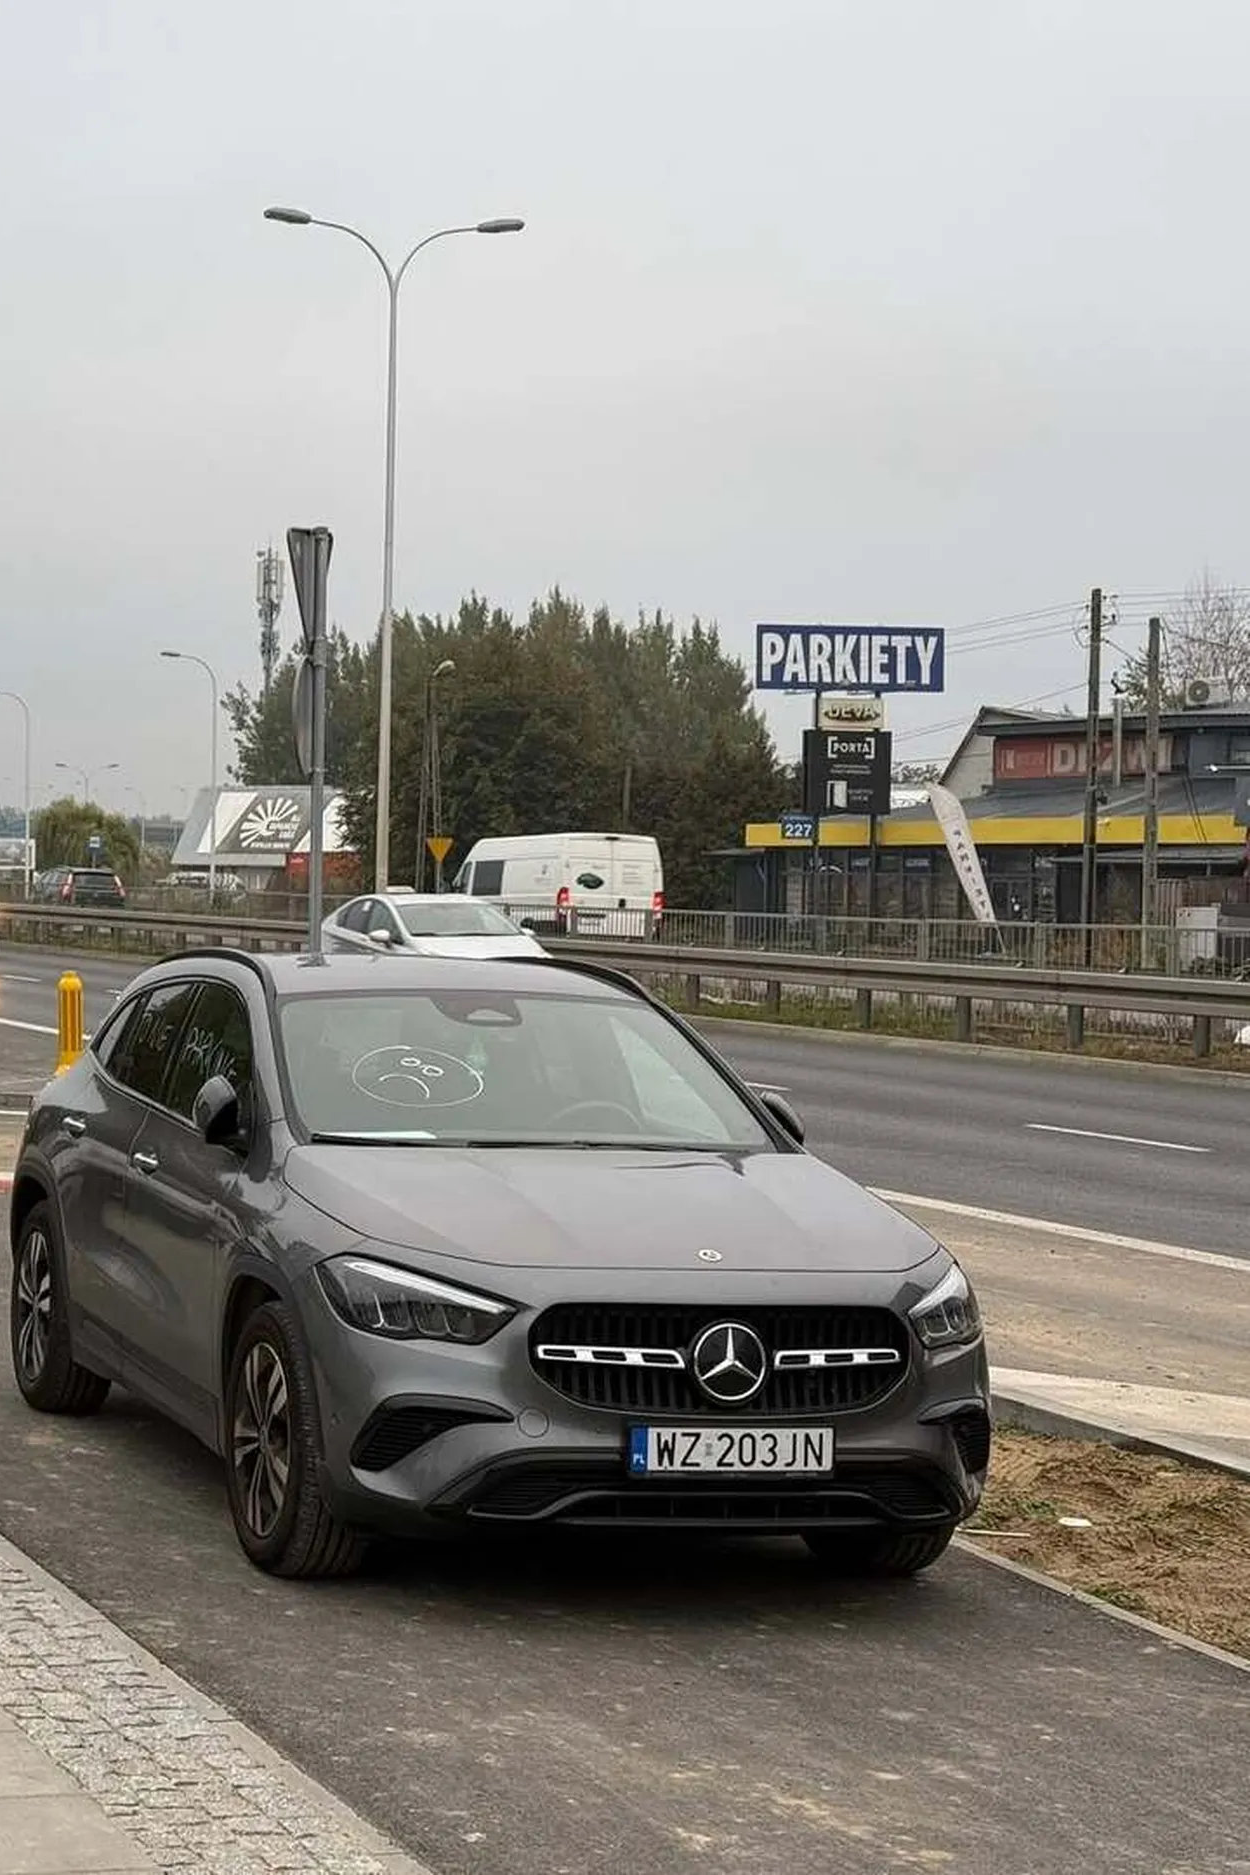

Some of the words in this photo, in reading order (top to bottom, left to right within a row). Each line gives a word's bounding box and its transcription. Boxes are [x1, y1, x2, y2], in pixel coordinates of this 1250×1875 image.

[762, 632, 937, 685] PARKIETY
[784, 823, 813, 838] 227
[656, 1431, 701, 1468] WZ
[716, 1431, 824, 1468] 203JN
